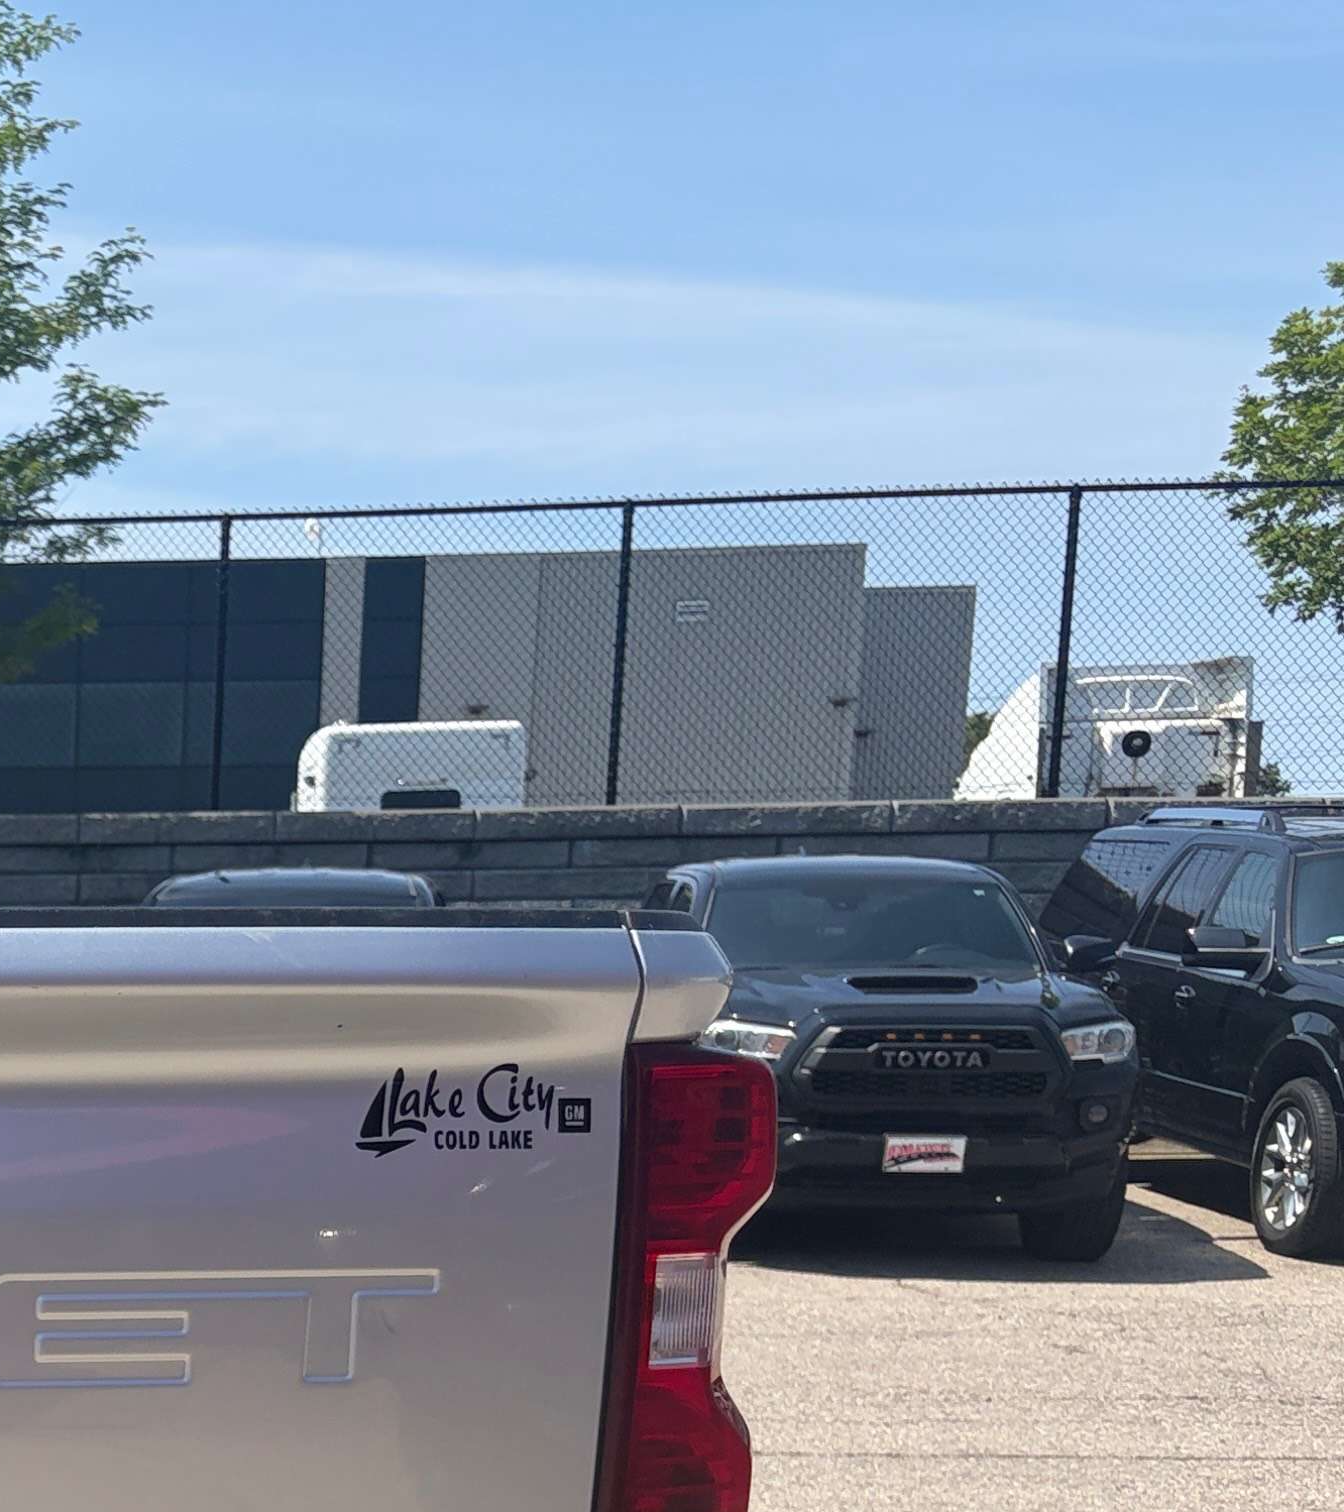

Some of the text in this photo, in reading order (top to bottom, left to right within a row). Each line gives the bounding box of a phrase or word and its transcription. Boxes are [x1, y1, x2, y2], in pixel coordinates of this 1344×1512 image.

[883, 1052, 983, 1068] TOYOTA
[388, 1063, 555, 1137] Lake City
[564, 1104, 585, 1121] GM
[434, 1130, 533, 1150] COLD LAKE
